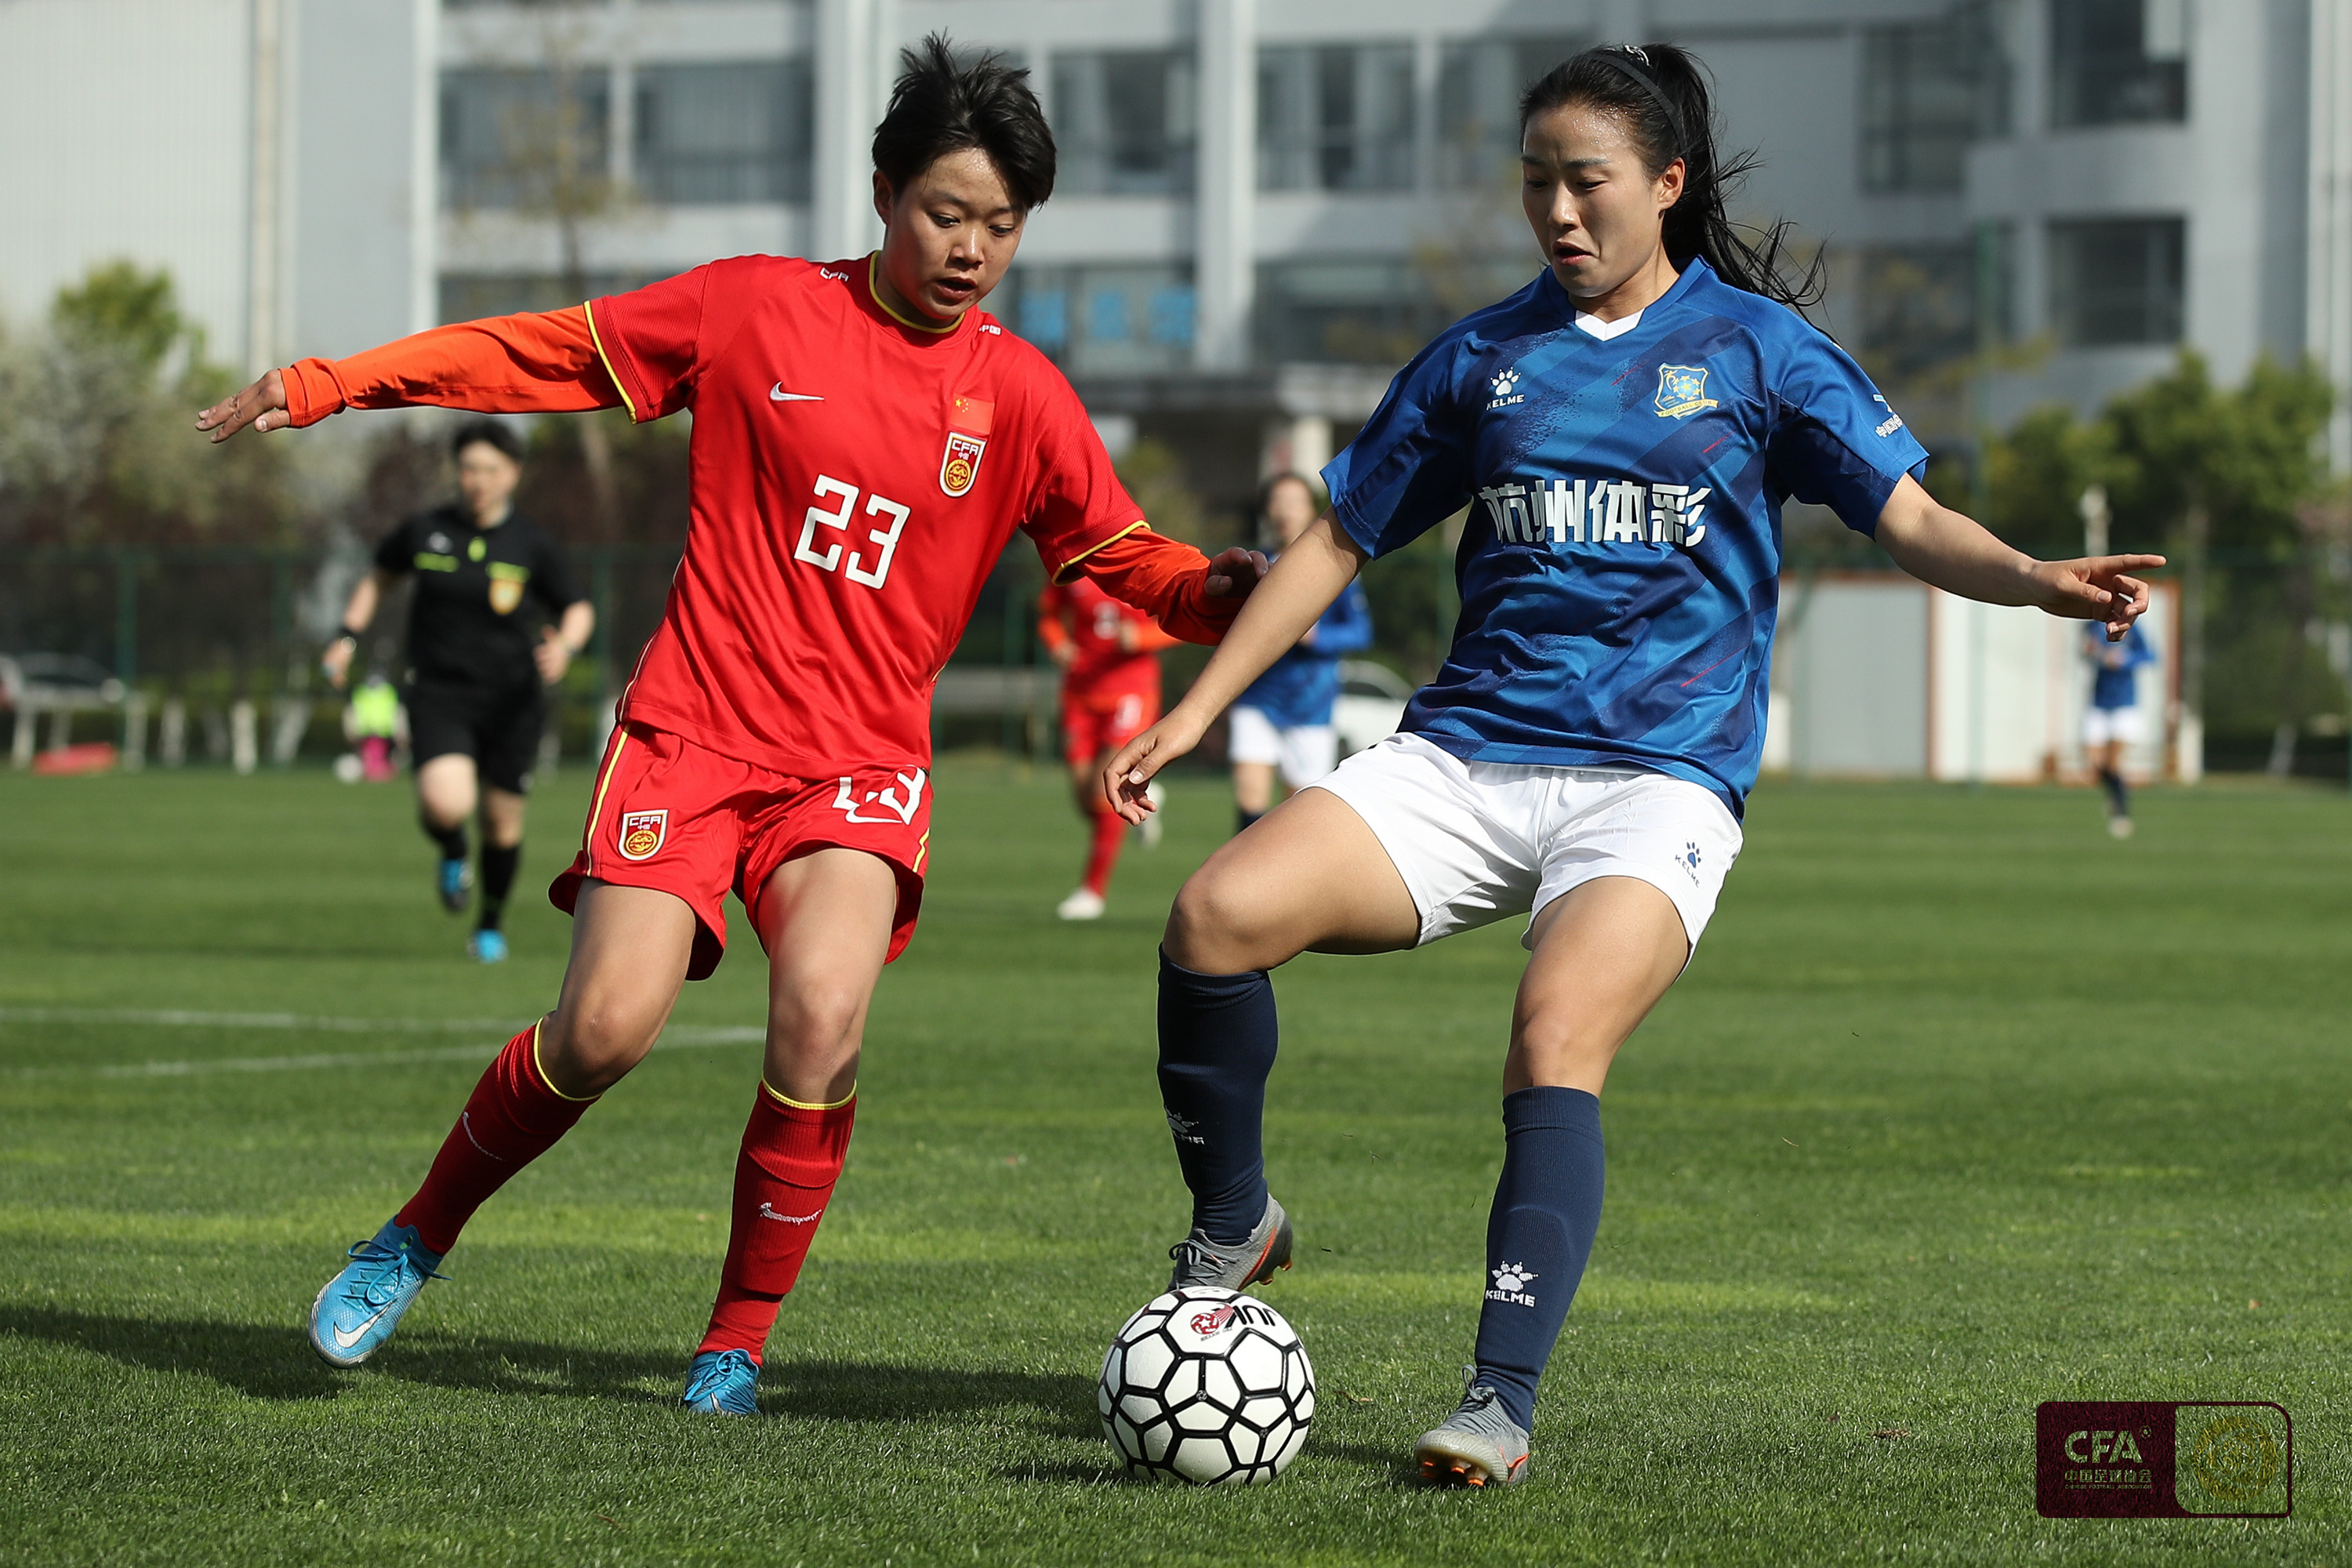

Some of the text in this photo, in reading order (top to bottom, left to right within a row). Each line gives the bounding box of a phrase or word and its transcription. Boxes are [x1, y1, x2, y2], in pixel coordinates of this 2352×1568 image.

[1661, 402, 1693, 416] FOOTBALL
[951, 439, 979, 456] CFA
[1478, 479, 1712, 547] 杭州体彩
[793, 474, 911, 590] 23
[629, 815, 662, 826] CFA
[1485, 1290, 1536, 1307] KELME
